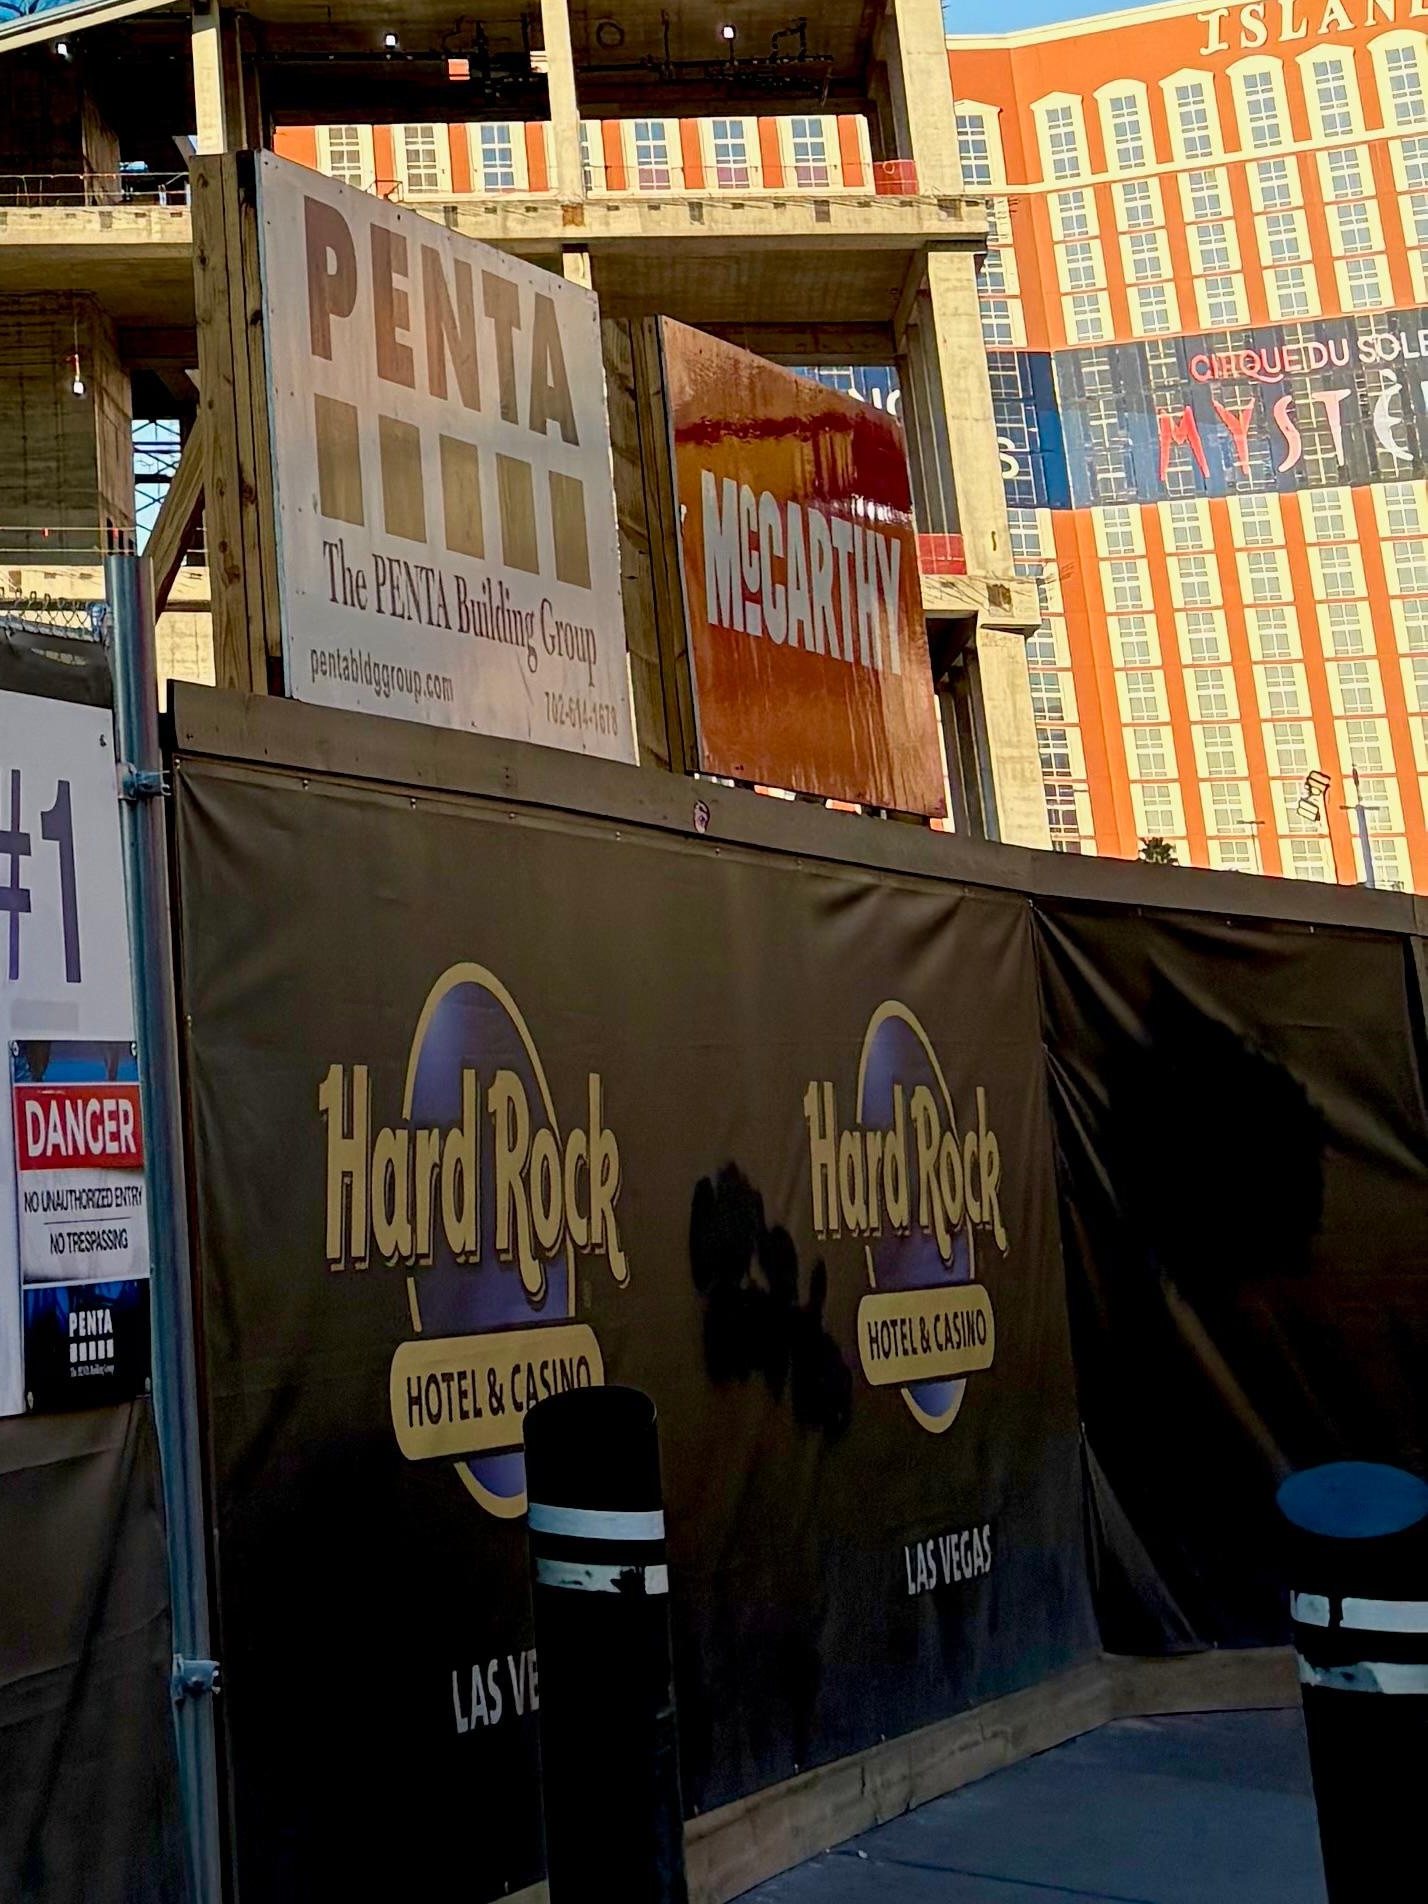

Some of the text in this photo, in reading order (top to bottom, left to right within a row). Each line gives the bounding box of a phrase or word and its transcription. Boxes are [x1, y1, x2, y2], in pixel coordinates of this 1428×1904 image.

[304, 195, 580, 447] PENTA
[1189, 344, 1303, 384] CIRQUE
[1308, 338, 1349, 370] DU
[323, 538, 597, 687] The PENTA Building Group
[310, 647, 454, 704] pentabldggroup.com
[25, 1098, 136, 1157] DANGER
[24, 1186, 142, 1213] NO UNAUTHORIZED ENTRY
[319, 1064, 630, 1301] Hard Rock
[804, 1081, 1009, 1265] Hard Rock
[50, 1228, 128, 1255] NO TRESPASSING
[69, 1308, 113, 1337] PENTA
[868, 1308, 987, 1360] HOTEL & CASINO
[406, 1370, 482, 1428] HOTEL
[488, 1367, 505, 1416] &
[904, 1524, 991, 1595] LAS VEGAS
[452, 1659, 502, 1733] LAS
